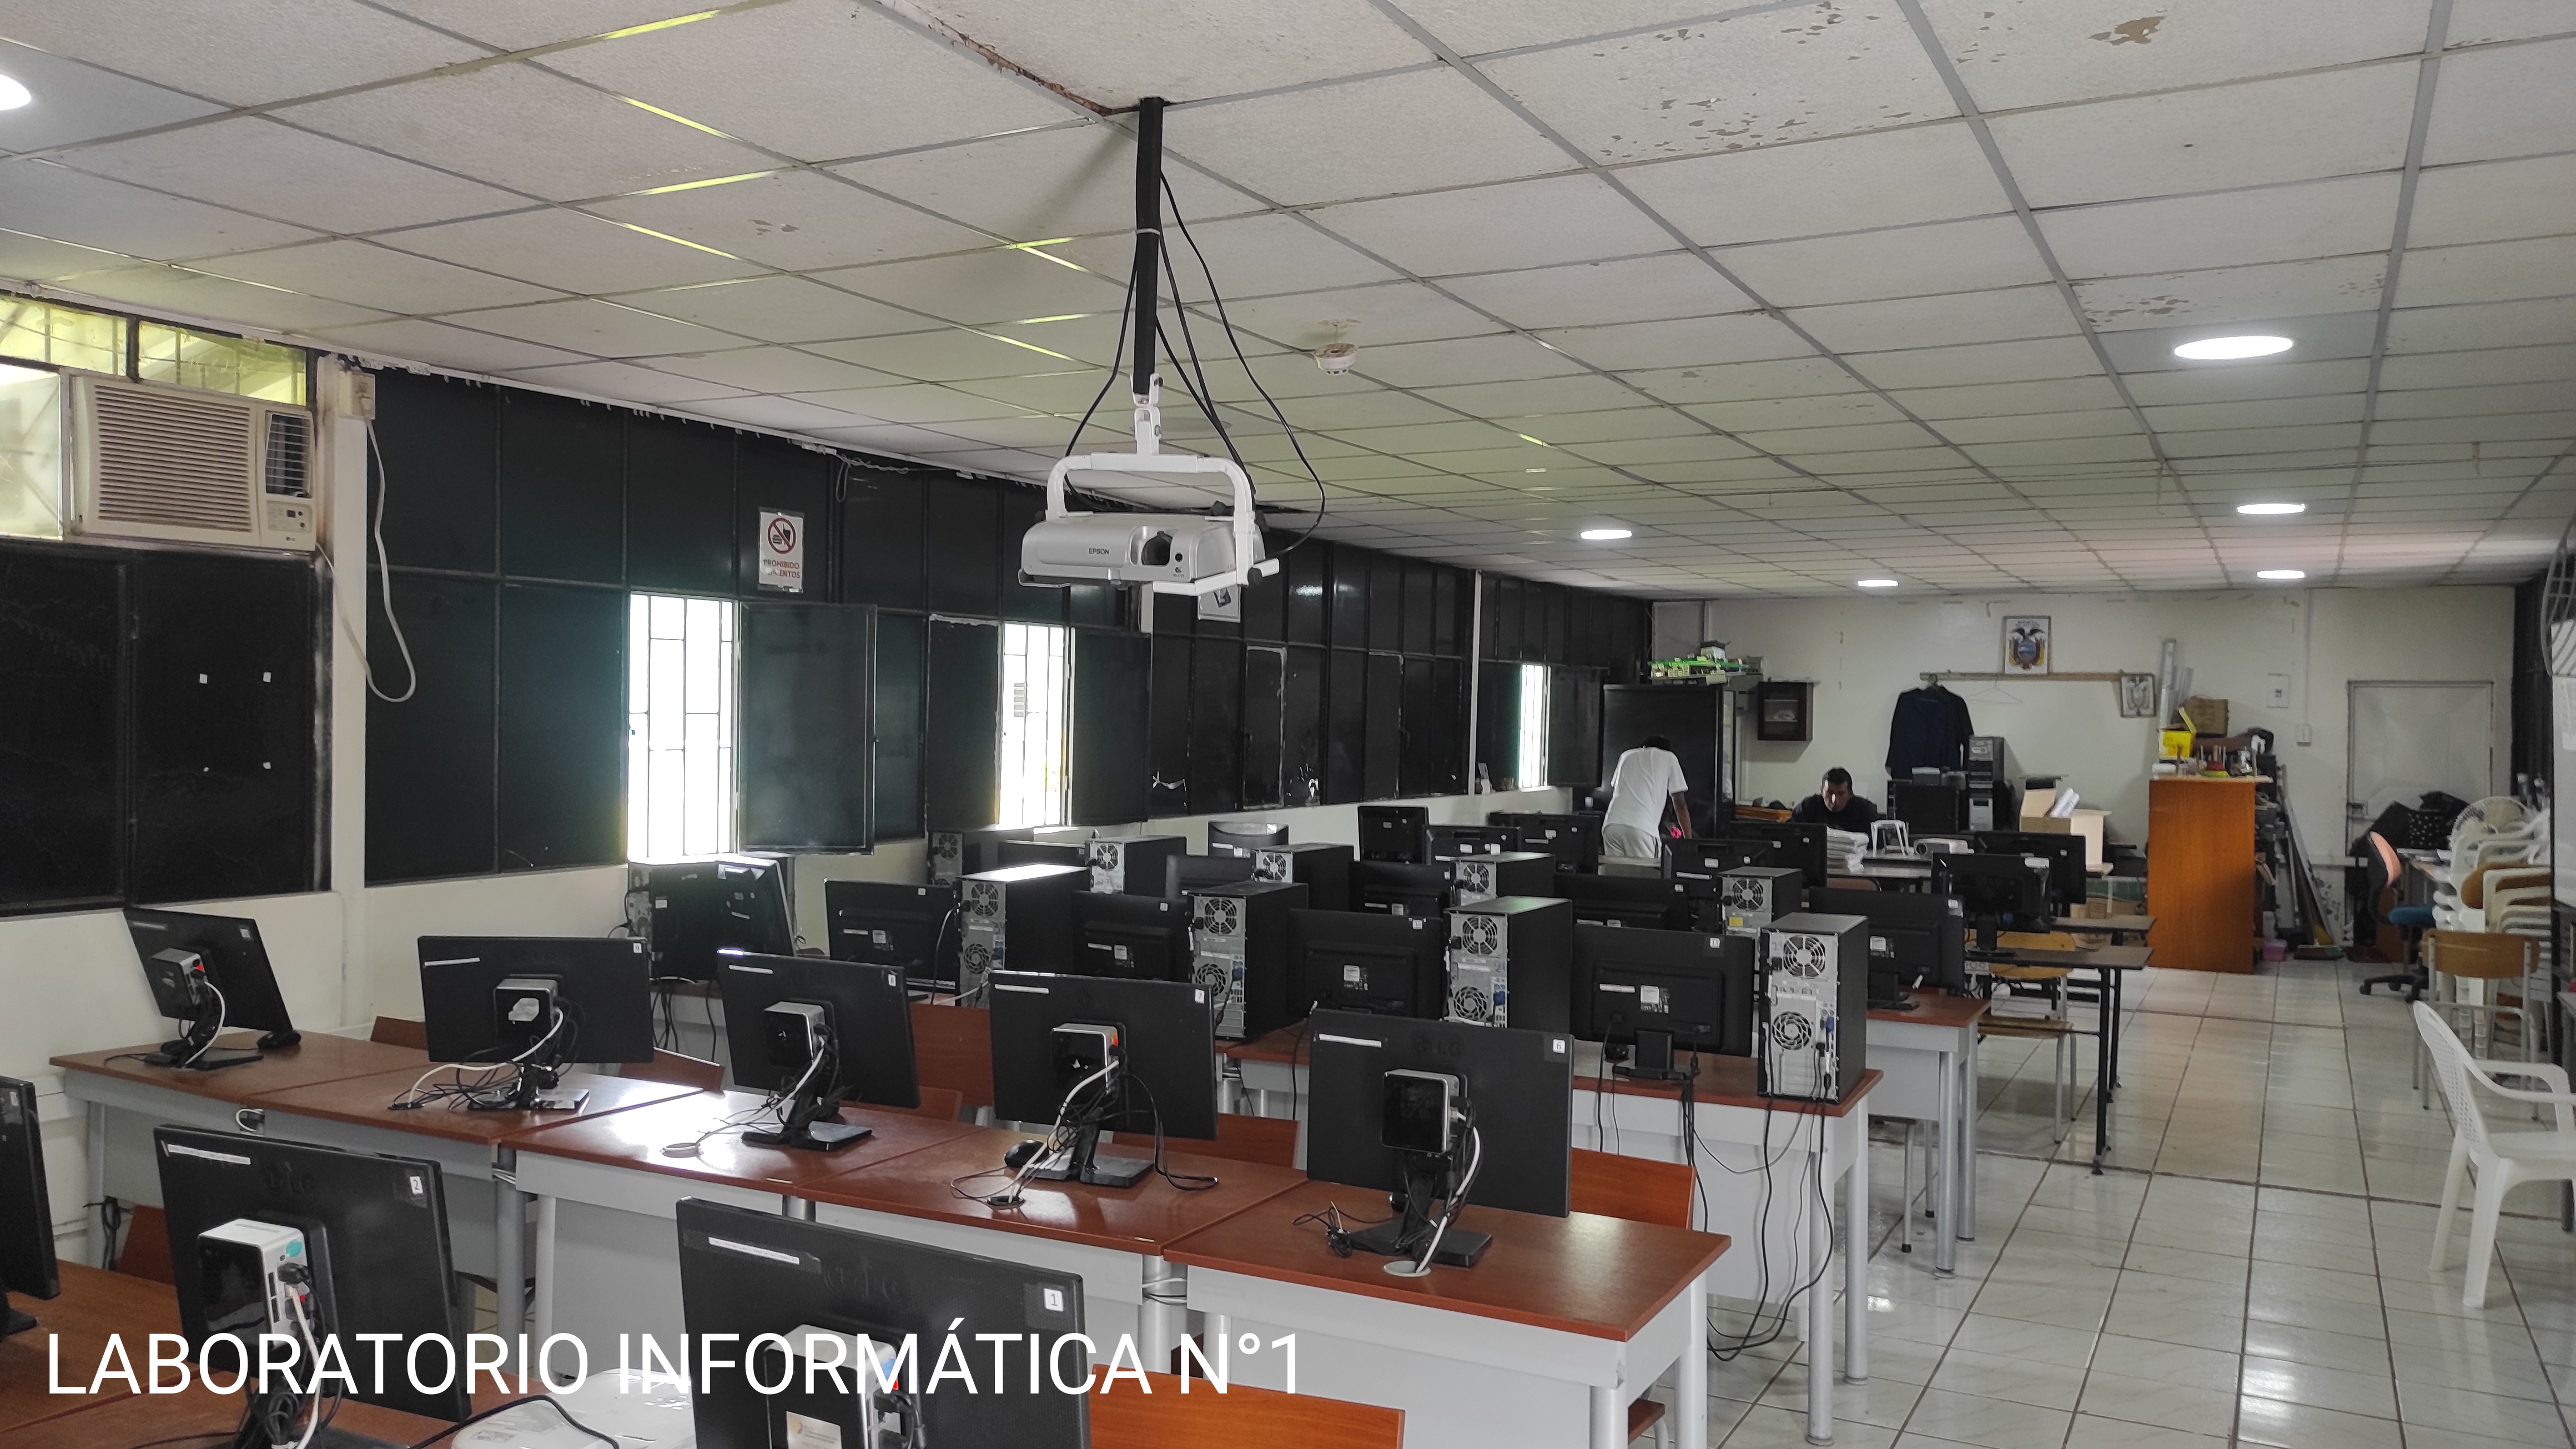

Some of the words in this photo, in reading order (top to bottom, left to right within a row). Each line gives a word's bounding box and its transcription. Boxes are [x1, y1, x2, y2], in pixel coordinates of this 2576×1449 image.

[763, 559, 799, 570] PROHIBIDO
[1436, 1038, 1463, 1057] LG
[414, 1179, 420, 1190] 2
[1051, 1294, 1058, 1306] 1
